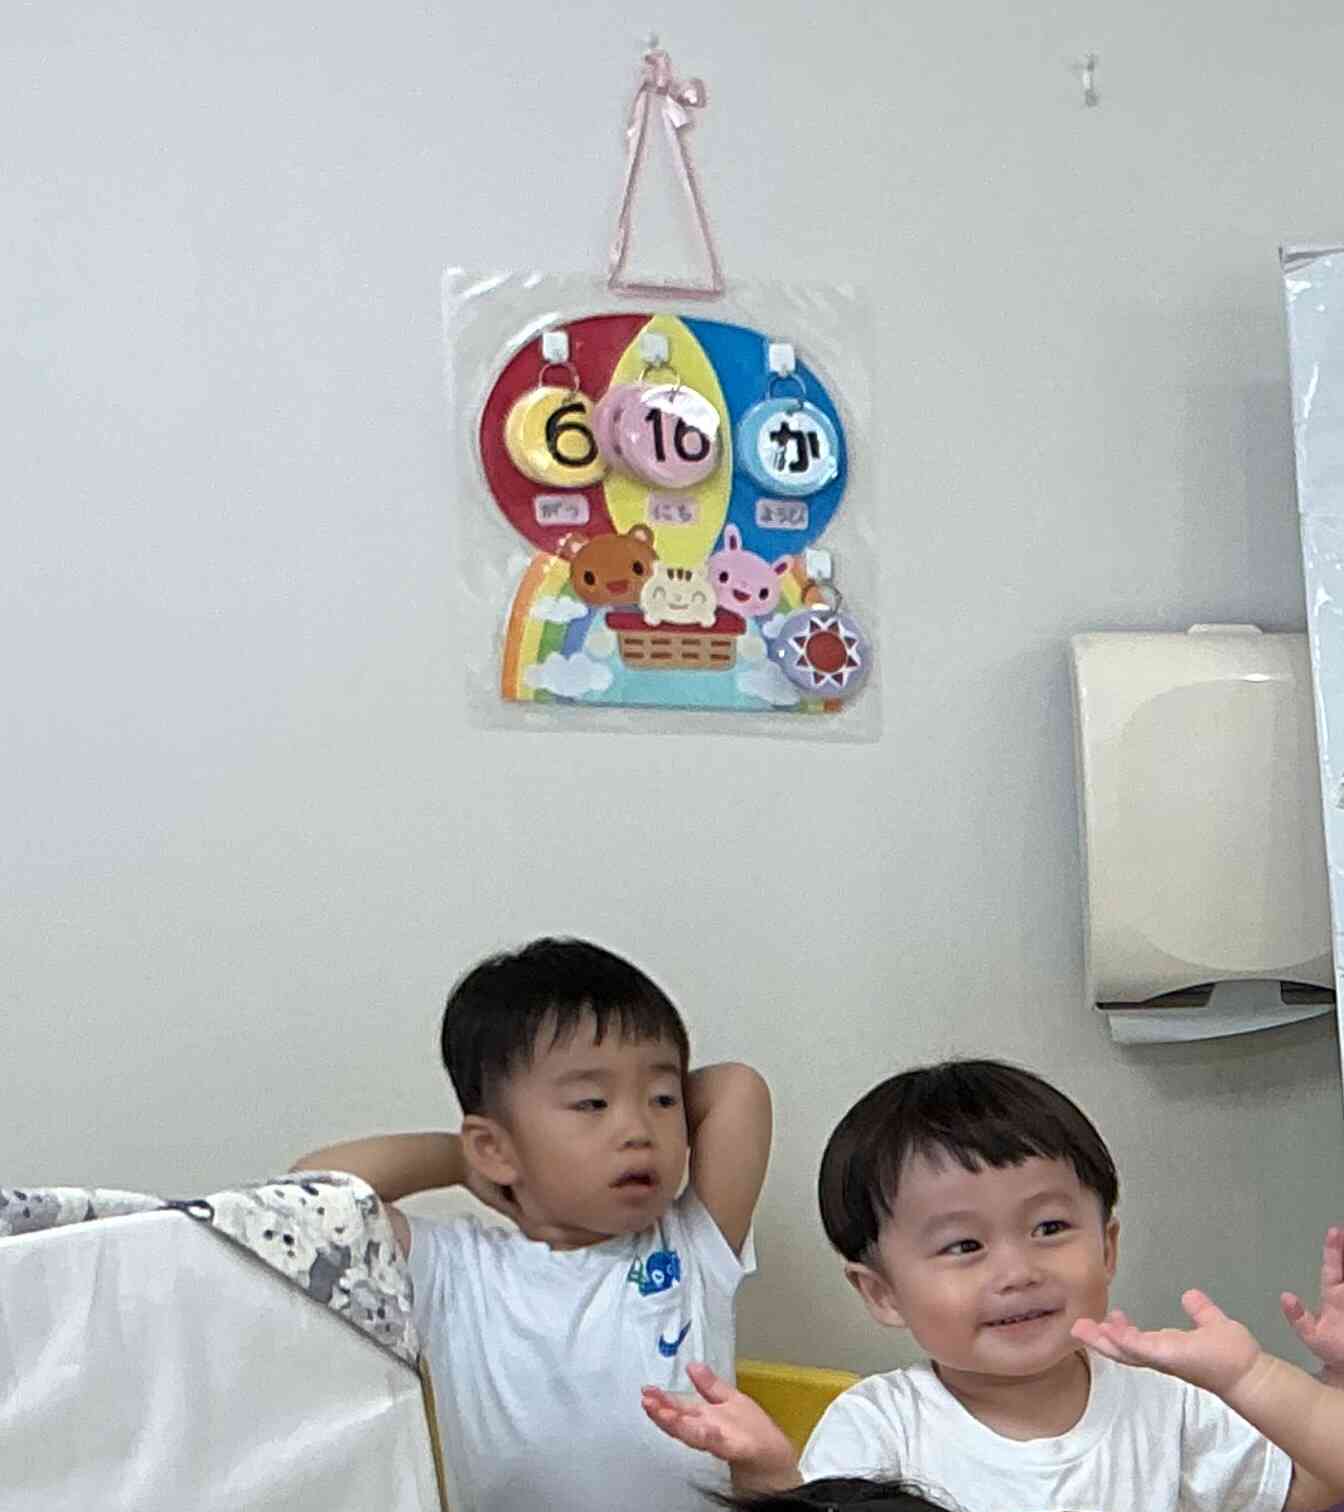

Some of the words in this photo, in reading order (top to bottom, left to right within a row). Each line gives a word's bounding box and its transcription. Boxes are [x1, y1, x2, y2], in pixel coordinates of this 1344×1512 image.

[545, 402, 598, 467] 6
[644, 408, 711, 463] 16
[769, 421, 820, 473] か
